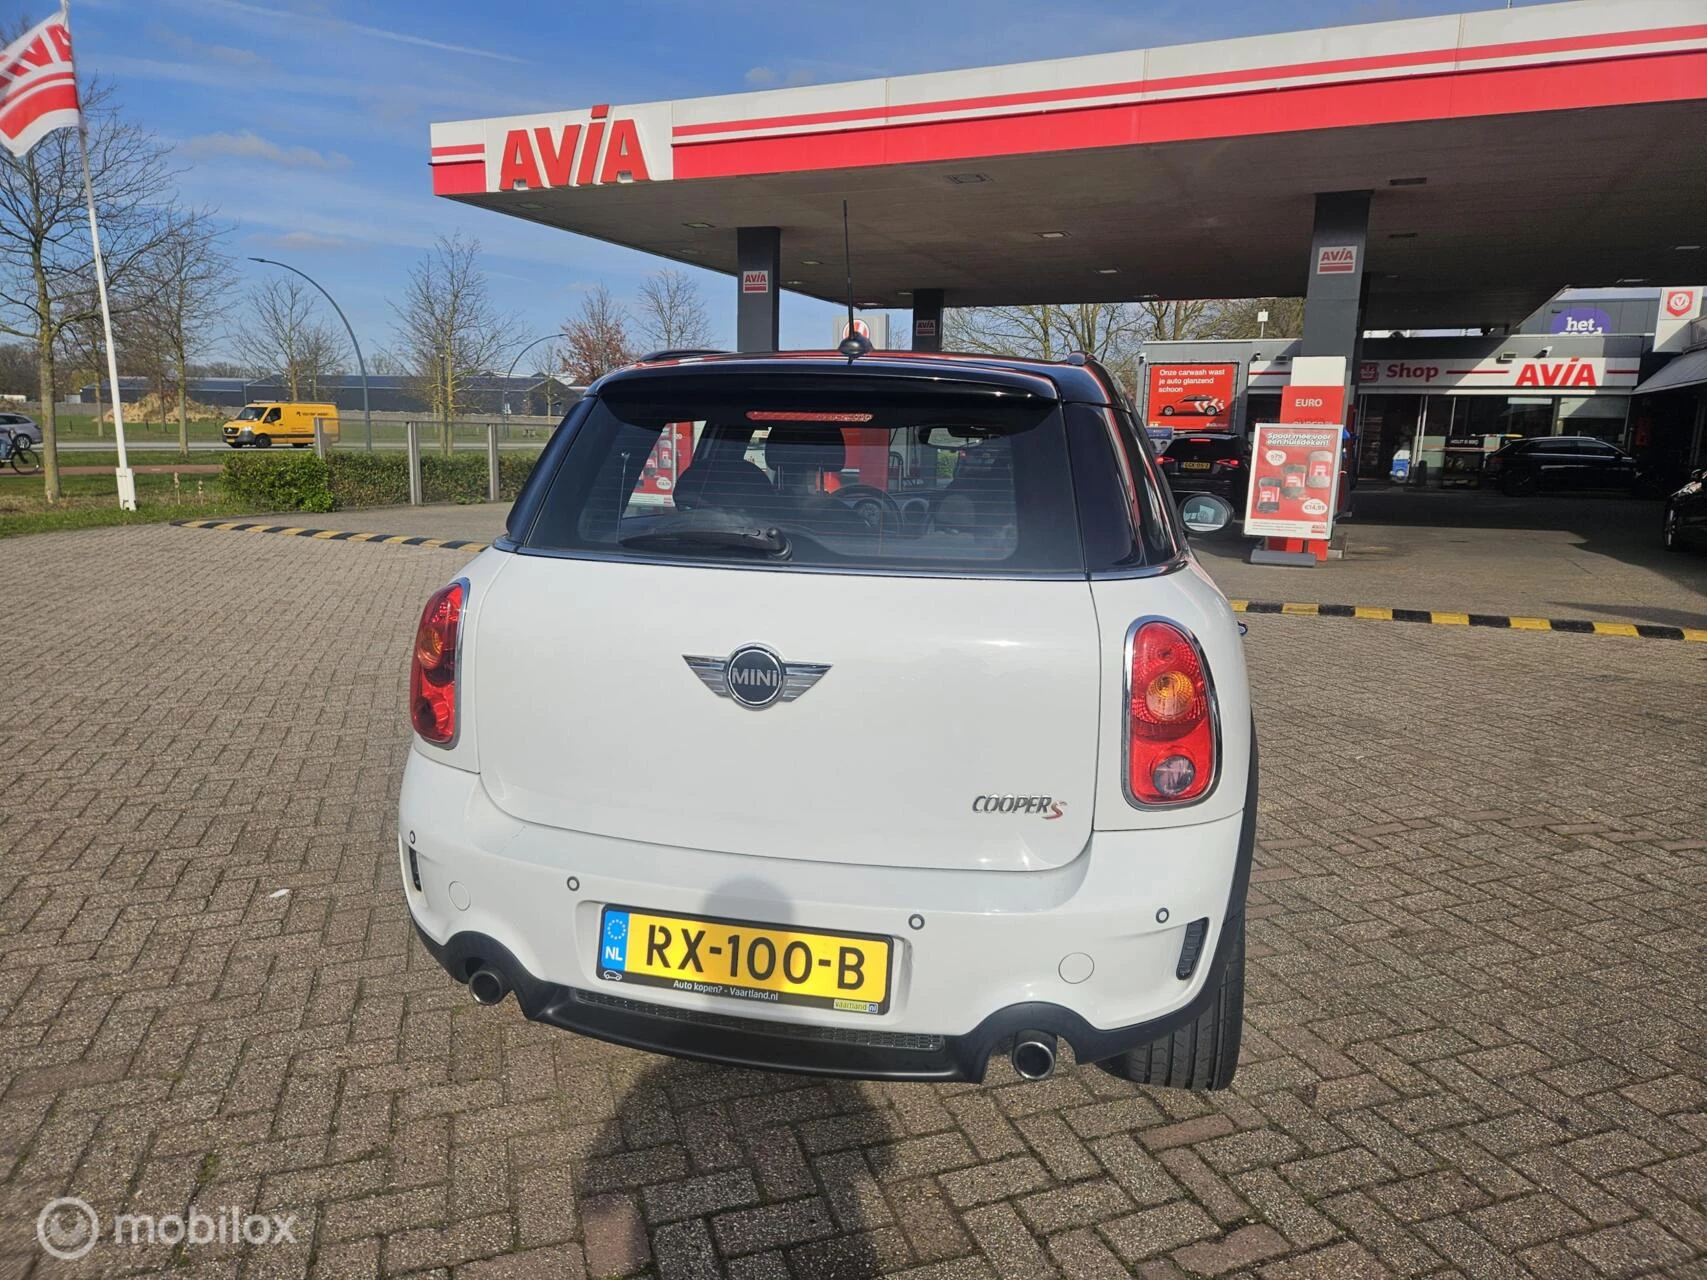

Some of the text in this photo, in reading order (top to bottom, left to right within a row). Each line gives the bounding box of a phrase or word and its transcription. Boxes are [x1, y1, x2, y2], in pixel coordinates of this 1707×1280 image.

[499, 104, 650, 191] AVIA
[1321, 248, 1354, 262] AVIA
[744, 271, 767, 283] AVIA
[1565, 316, 1595, 331] het
[1160, 368, 1225, 376] Onze carwash wast
[1386, 362, 1439, 383] Shop
[1514, 357, 1597, 387] AVIA
[1158, 377, 1214, 386] je auto glanzend
[1295, 398, 1323, 407] EURO
[1267, 432, 1291, 440] Spaar
[732, 667, 777, 687] MINI
[605, 945, 623, 962] NL
[646, 924, 865, 991] RX-100-B
[673, 980, 693, 991] Auto
[693, 981, 722, 995] kopen?
[730, 987, 778, 1001] Vaartland.nl
